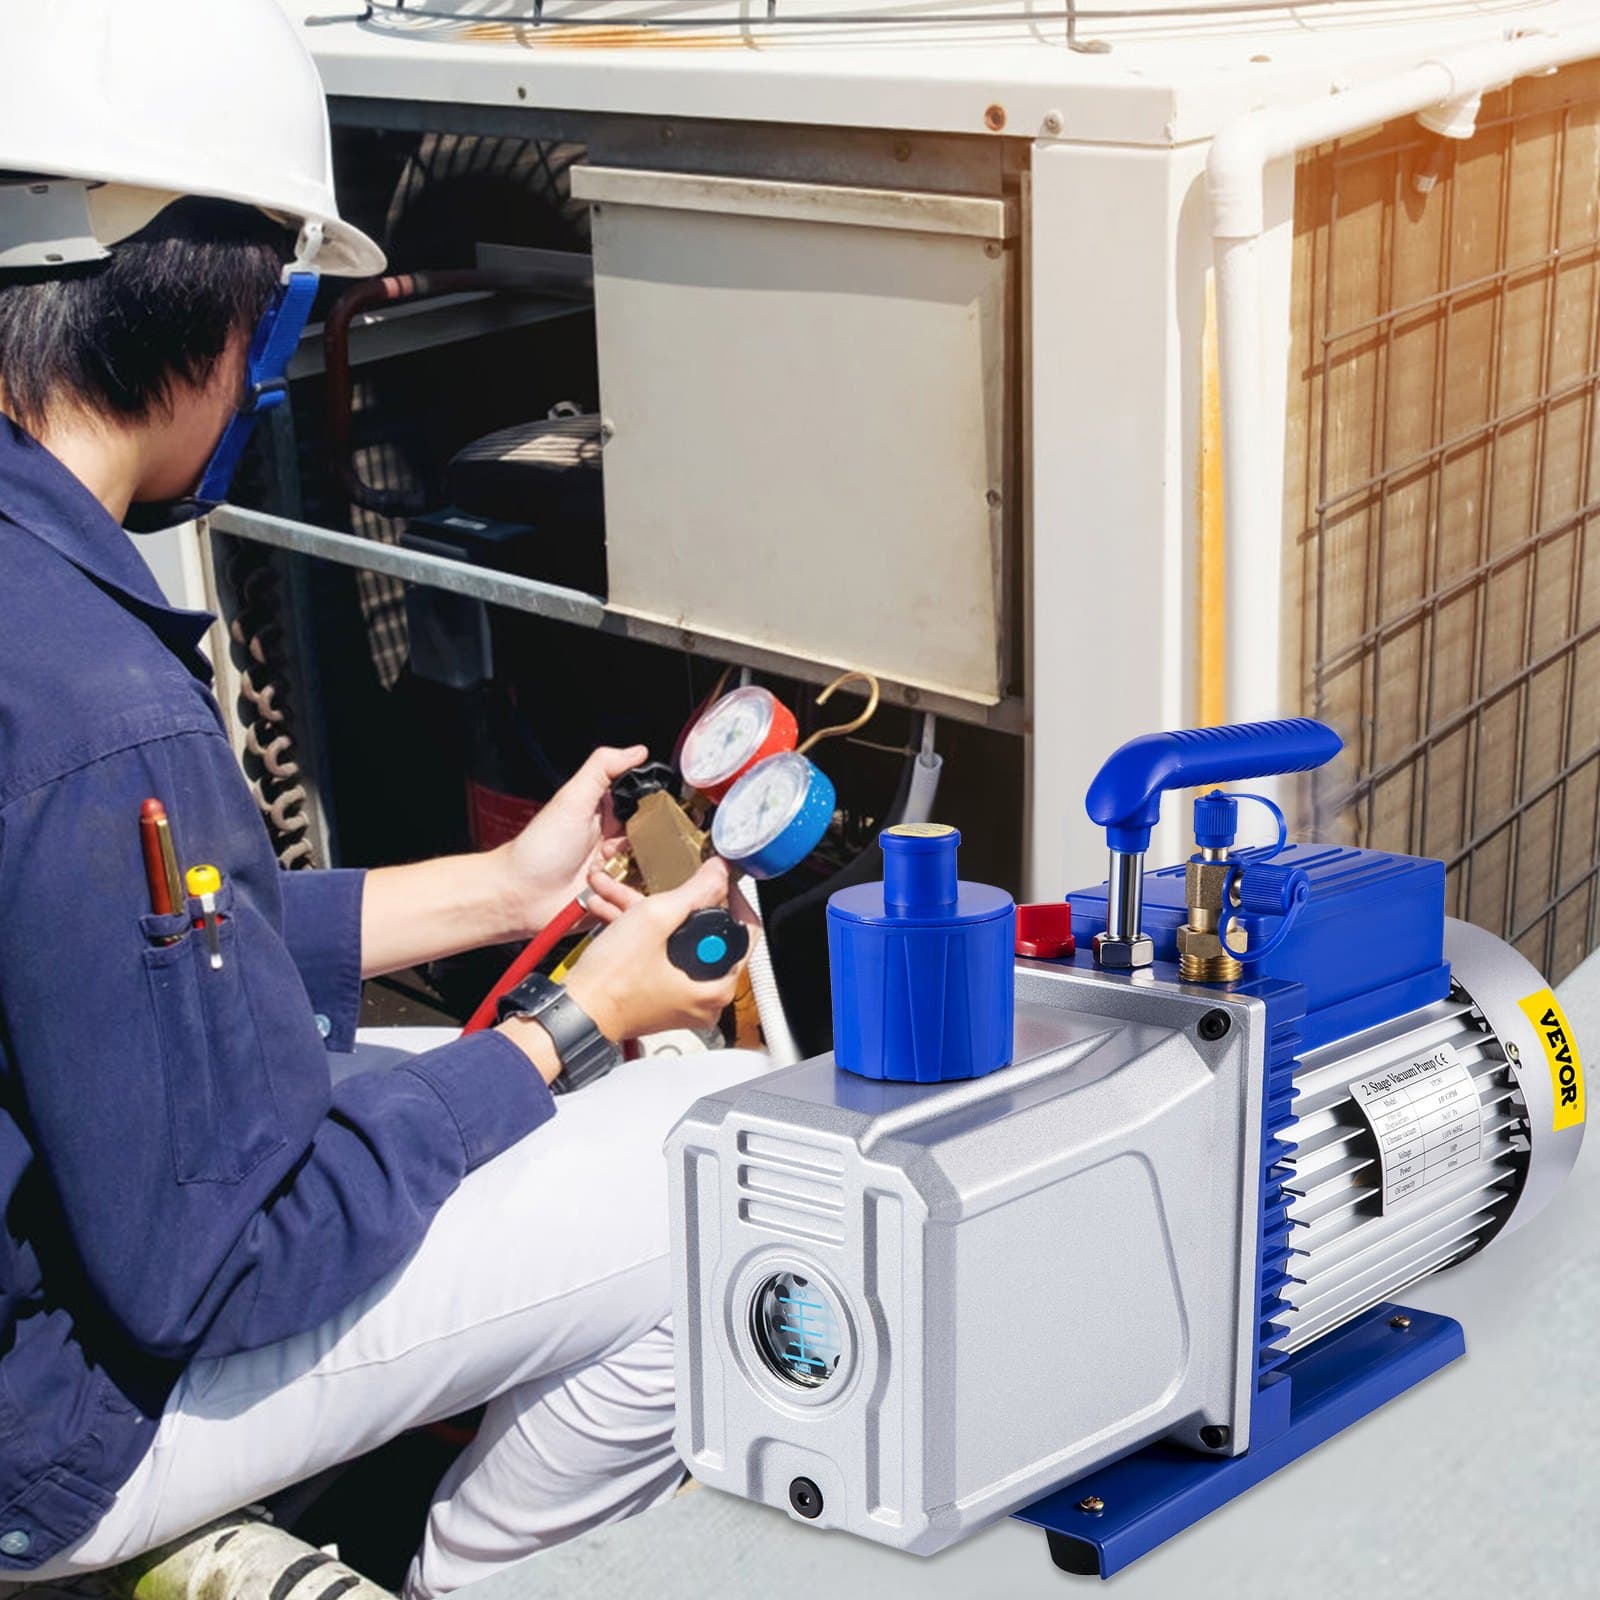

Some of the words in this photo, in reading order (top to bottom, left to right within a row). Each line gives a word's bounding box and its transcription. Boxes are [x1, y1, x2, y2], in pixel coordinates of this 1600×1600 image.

[1361, 1084, 1371, 1096] 2
[1368, 1079, 1392, 1093] Stage
[1386, 1067, 1419, 1084] Vacuum
[1413, 1059, 1437, 1073] Pump
[1540, 1008, 1577, 1107] VEVOR
